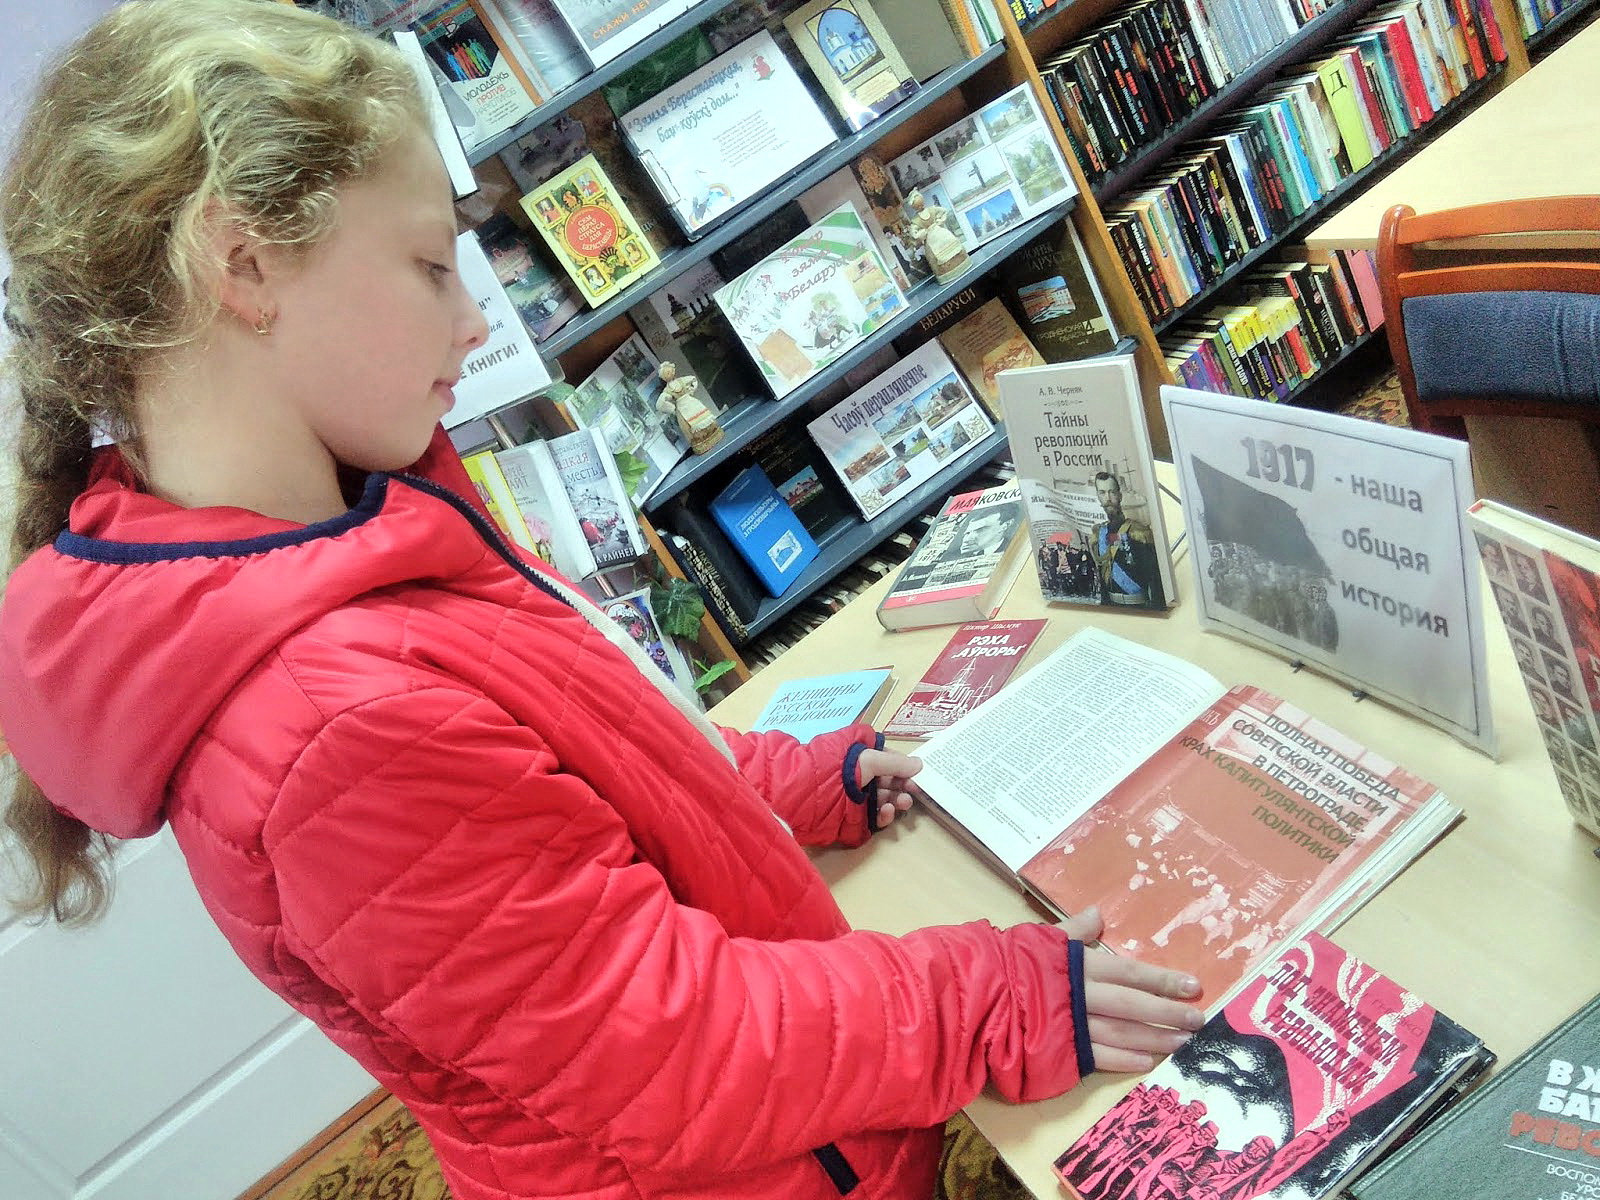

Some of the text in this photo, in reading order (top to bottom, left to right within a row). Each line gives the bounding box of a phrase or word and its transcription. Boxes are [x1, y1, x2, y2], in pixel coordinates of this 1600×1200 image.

[592, 13, 629, 40] СКАЖИ
[463, 72, 509, 101] МОЛОДЕЖЬ
[477, 84, 506, 106] ПРОТИВ
[919, 287, 977, 332] БЕЛАРУСИ
[467, 343, 520, 375] КНИГИ!
[831, 362, 928, 437] Часоў перапляценне
[1039, 386, 1083, 396] А. В. Черняк
[1044, 411, 1089, 428] Тайны
[1034, 430, 1109, 452] революций
[567, 463, 602, 484] месть!
[1043, 451, 1103, 467] в России
[1240, 436, 1315, 493] 1917
[1350, 473, 1425, 514] наша
[603, 547, 635, 562] РАЙНЕР
[1342, 527, 1431, 575] общая
[1341, 580, 1449, 638] история
[967, 635, 1010, 646] РЭХА
[769, 697, 836, 715] РУССКОЙ
[776, 682, 863, 703] ЖЕНЩИНЫ
[762, 705, 853, 727] РЕВОЛЮЦИИ
[1202, 709, 1221, 726] КЪ
[1232, 719, 1389, 817] СОВЕТСКОЙ ВЛАСТИ
[1264, 714, 1401, 800] ПОЛНАЯ ПОБЕДА
[1178, 735, 1357, 849] КРАХ КАПИТУЛЯНТСКОЙ
[1251, 754, 1369, 832] В ПЕТРОГРАДЕ.
[1251, 805, 1340, 864] ПОЛИТИКИ
[1267, 962, 1312, 1003] ПОД
[1301, 986, 1408, 1067] ЗНАМЕНЕМ
[1261, 1003, 1379, 1095] РЕВОЛЮЦИИ
[1546, 1059, 1574, 1086] В
[1509, 1110, 1600, 1157] РЕВО
